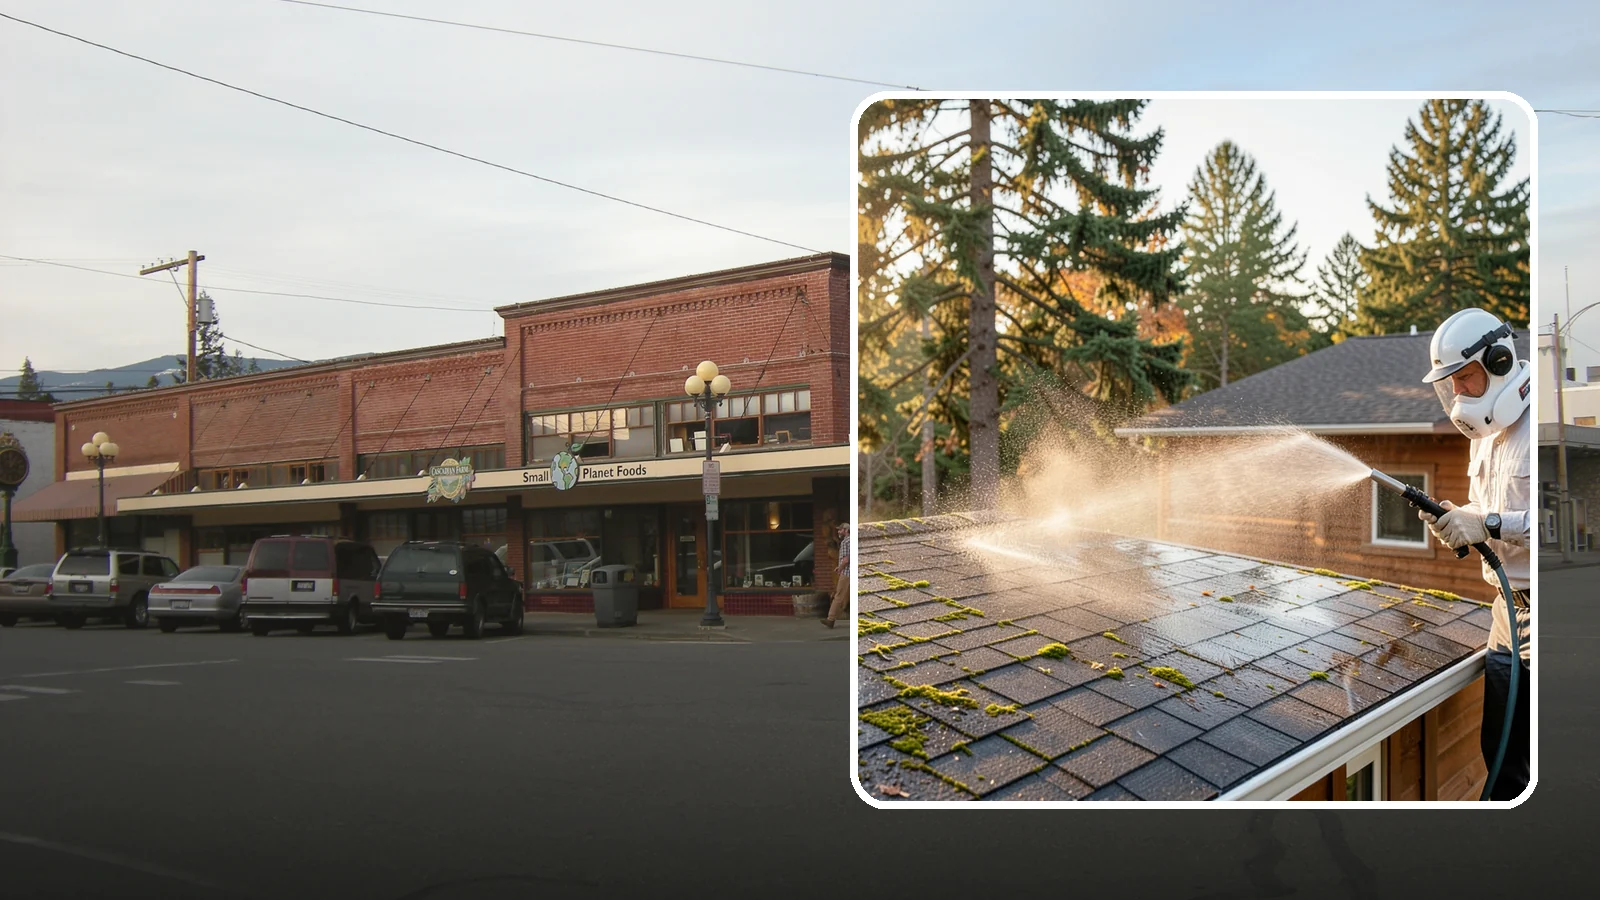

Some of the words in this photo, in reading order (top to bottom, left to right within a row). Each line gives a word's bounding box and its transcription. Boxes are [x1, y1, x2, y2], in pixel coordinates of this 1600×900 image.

[523, 471, 549, 482] Small
[583, 468, 614, 479] Planet
[617, 465, 647, 476] Foods
